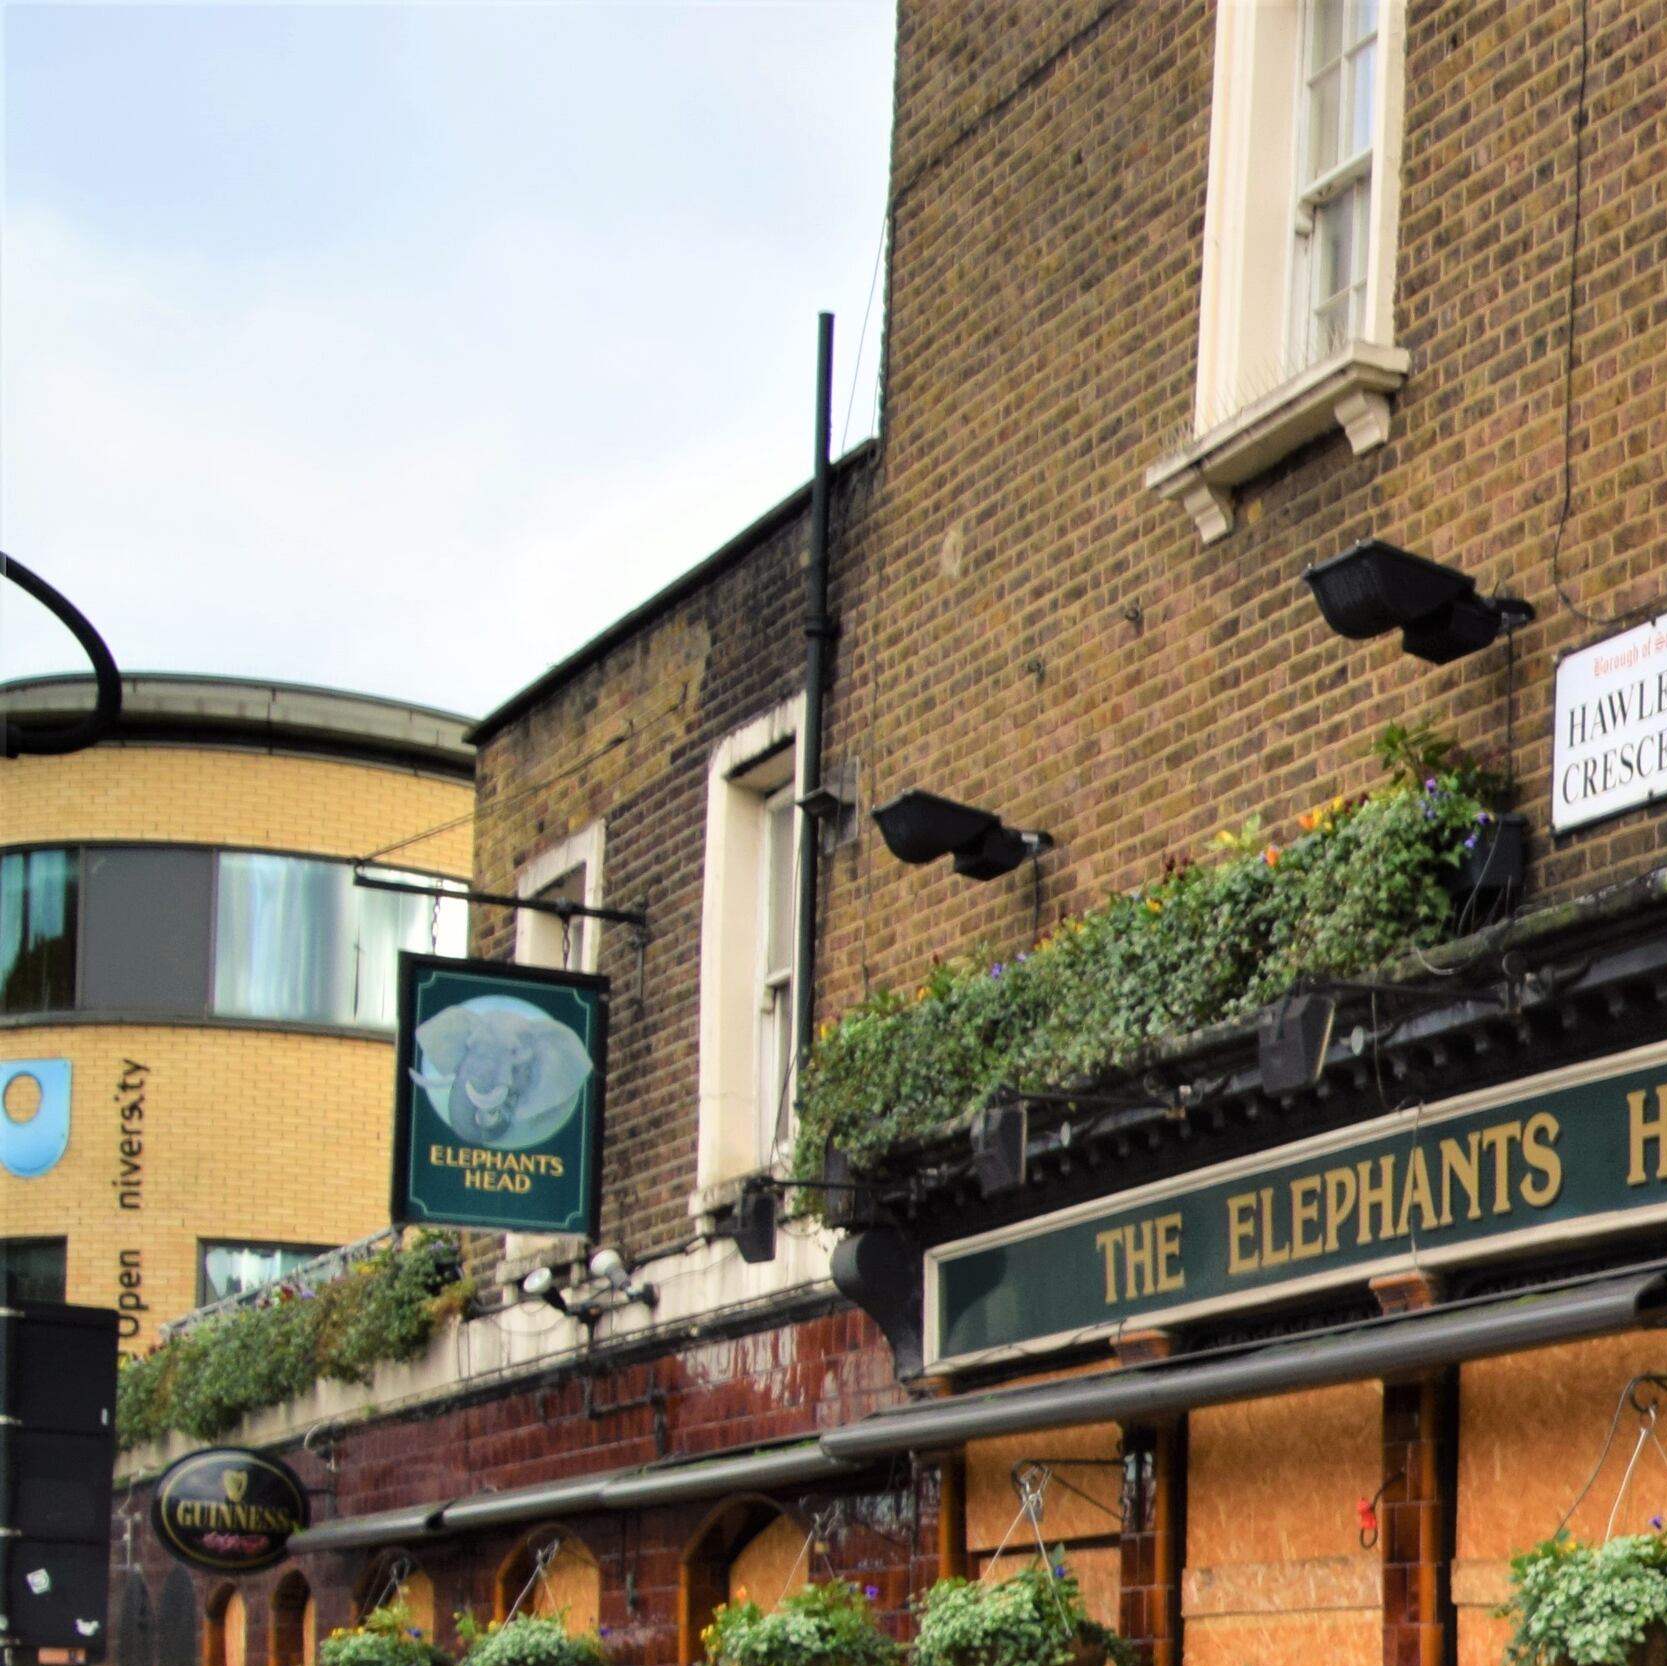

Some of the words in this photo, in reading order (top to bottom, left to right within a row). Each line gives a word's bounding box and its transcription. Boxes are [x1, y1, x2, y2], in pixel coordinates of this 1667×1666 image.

[1593, 644, 1640, 677] Borough
[464, 1169, 532, 1194] HEAD
[1095, 1212, 1187, 1304] THE
[1227, 1112, 1563, 1277] ELEPHANTS
[176, 1500, 291, 1533] GUINNESS
